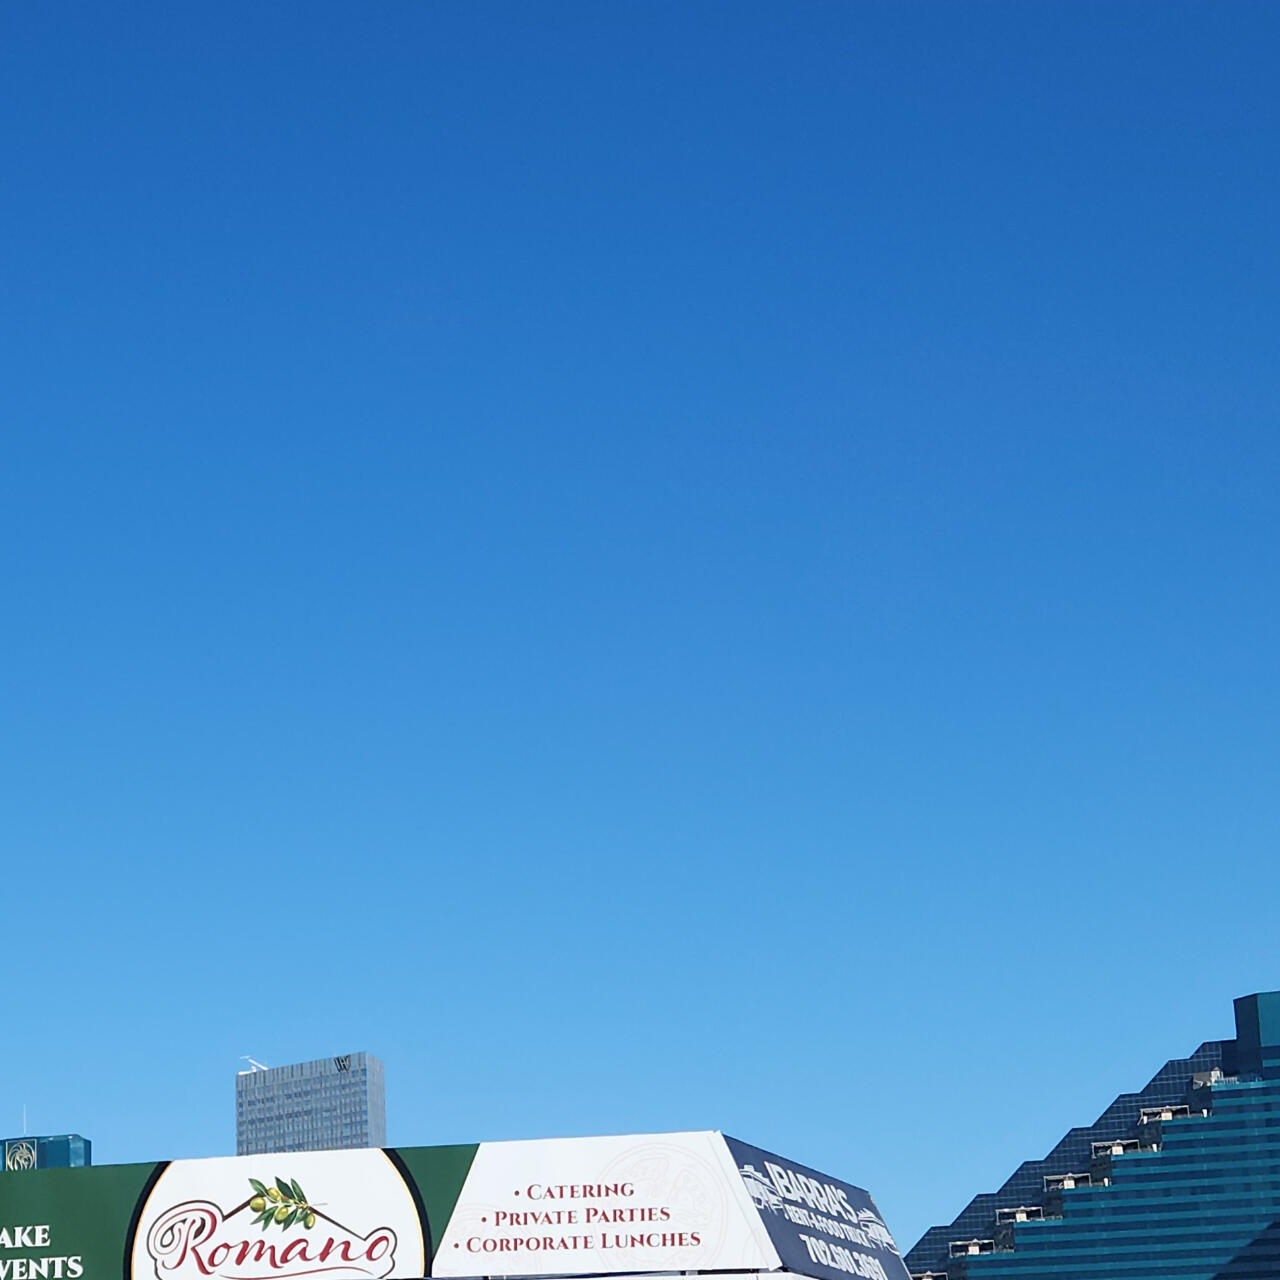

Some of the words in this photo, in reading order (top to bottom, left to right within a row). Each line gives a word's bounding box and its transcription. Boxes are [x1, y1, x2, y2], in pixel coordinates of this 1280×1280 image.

[527, 1182, 635, 1200] CATERING
[764, 1160, 859, 1224] IBARRA'S
[495, 1210, 578, 1227] PRIVATE
[585, 1207, 671, 1224] PARTIES
[153, 1208, 390, 1276] Romano
[466, 1234, 596, 1254] CORPORATE
[600, 1232, 702, 1250] LUNCHES
